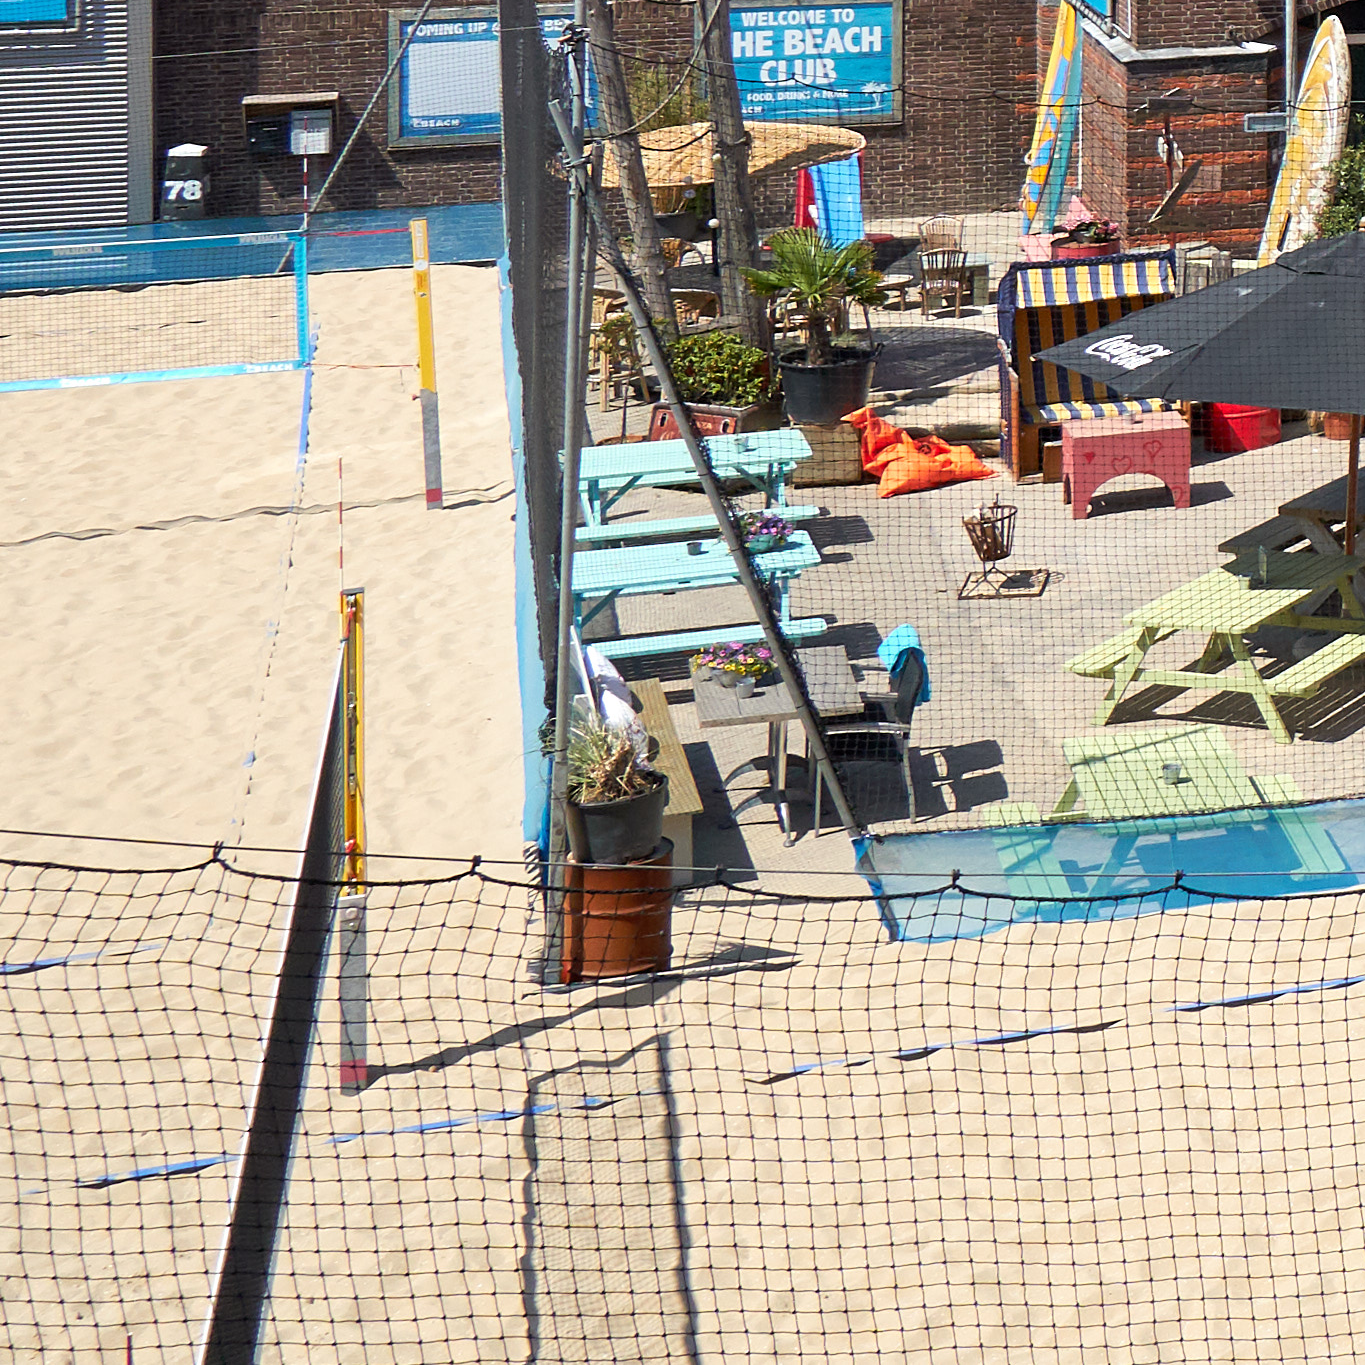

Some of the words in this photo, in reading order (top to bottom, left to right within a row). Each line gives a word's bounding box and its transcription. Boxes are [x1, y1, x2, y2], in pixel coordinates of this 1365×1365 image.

[468, 21, 488, 34] UP
[741, 10, 826, 27] WELCOME
[831, 8, 855, 24] TO
[733, 30, 773, 58] HE
[784, 26, 882, 56] BEACH
[759, 58, 838, 87] CLUB
[747, 92, 775, 103] FOOD,
[164, 179, 203, 201] 78
